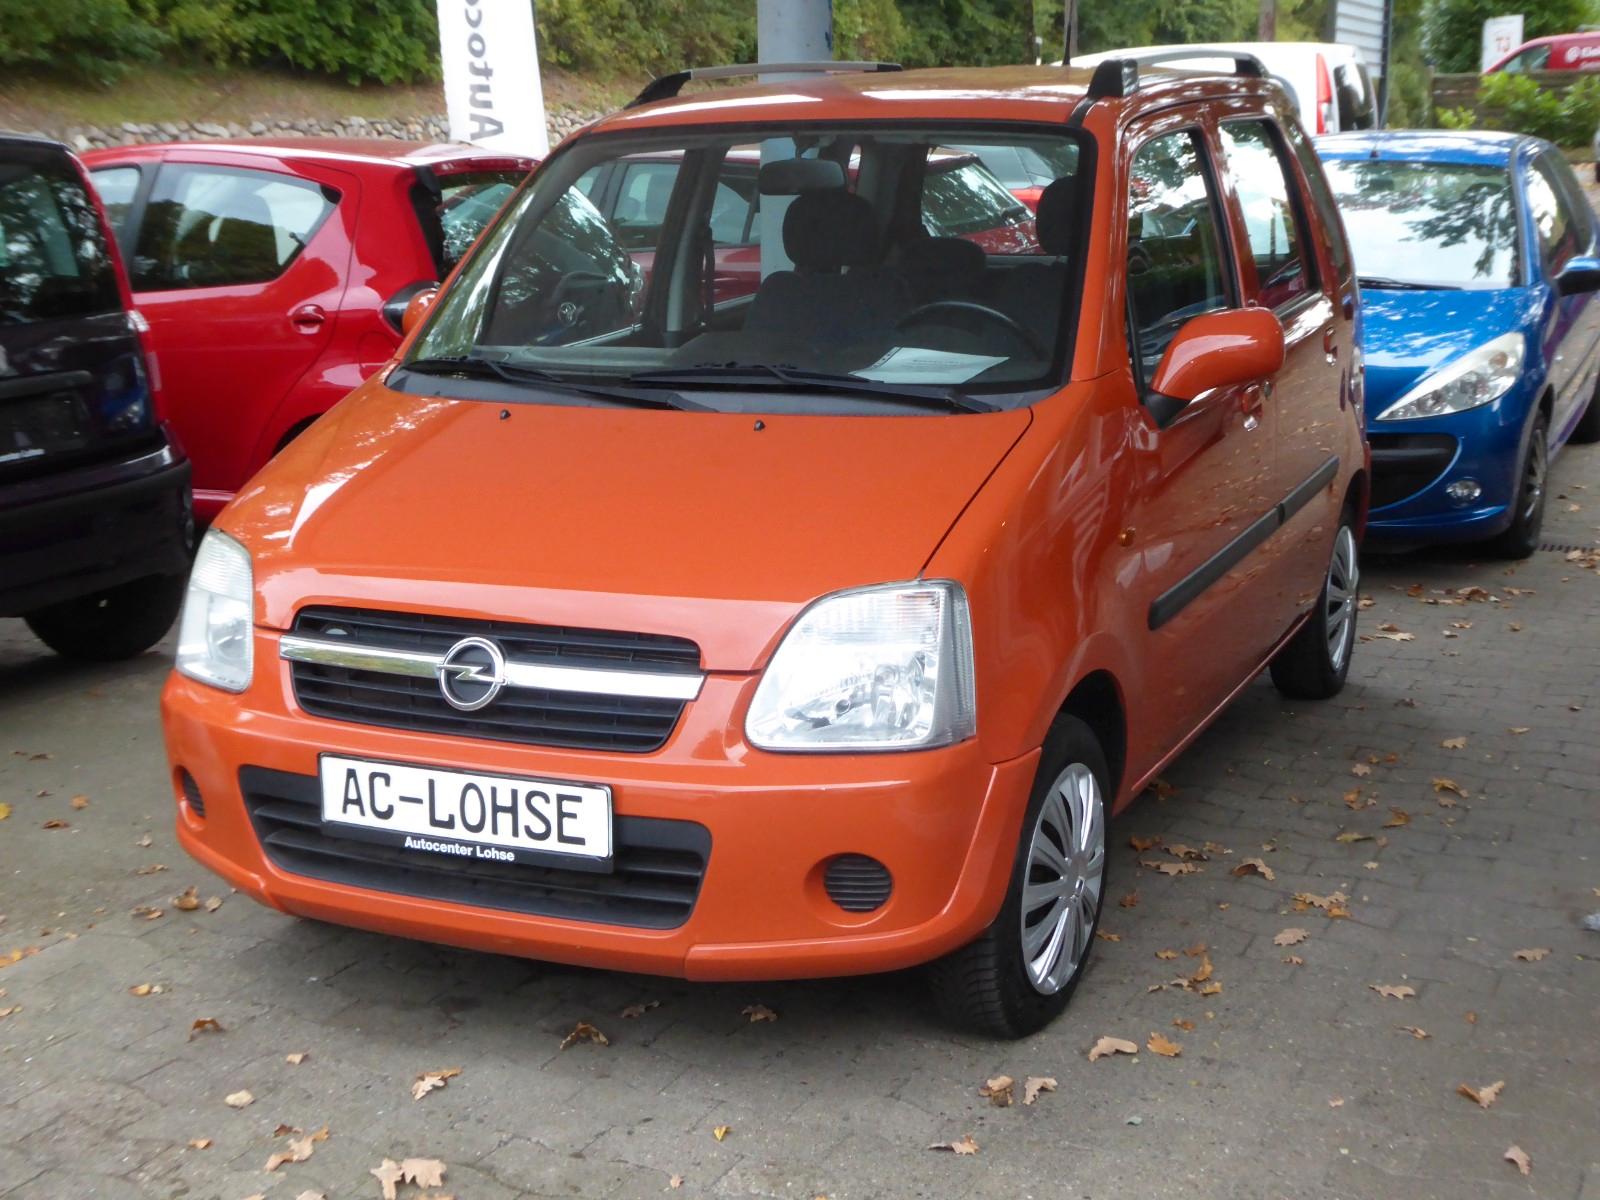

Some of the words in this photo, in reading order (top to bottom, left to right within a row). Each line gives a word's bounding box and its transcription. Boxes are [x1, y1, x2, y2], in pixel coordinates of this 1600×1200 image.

[342, 768, 586, 846] AC-LOHSE
[404, 836, 473, 856] Autocenter
[476, 846, 515, 861] Lohse
